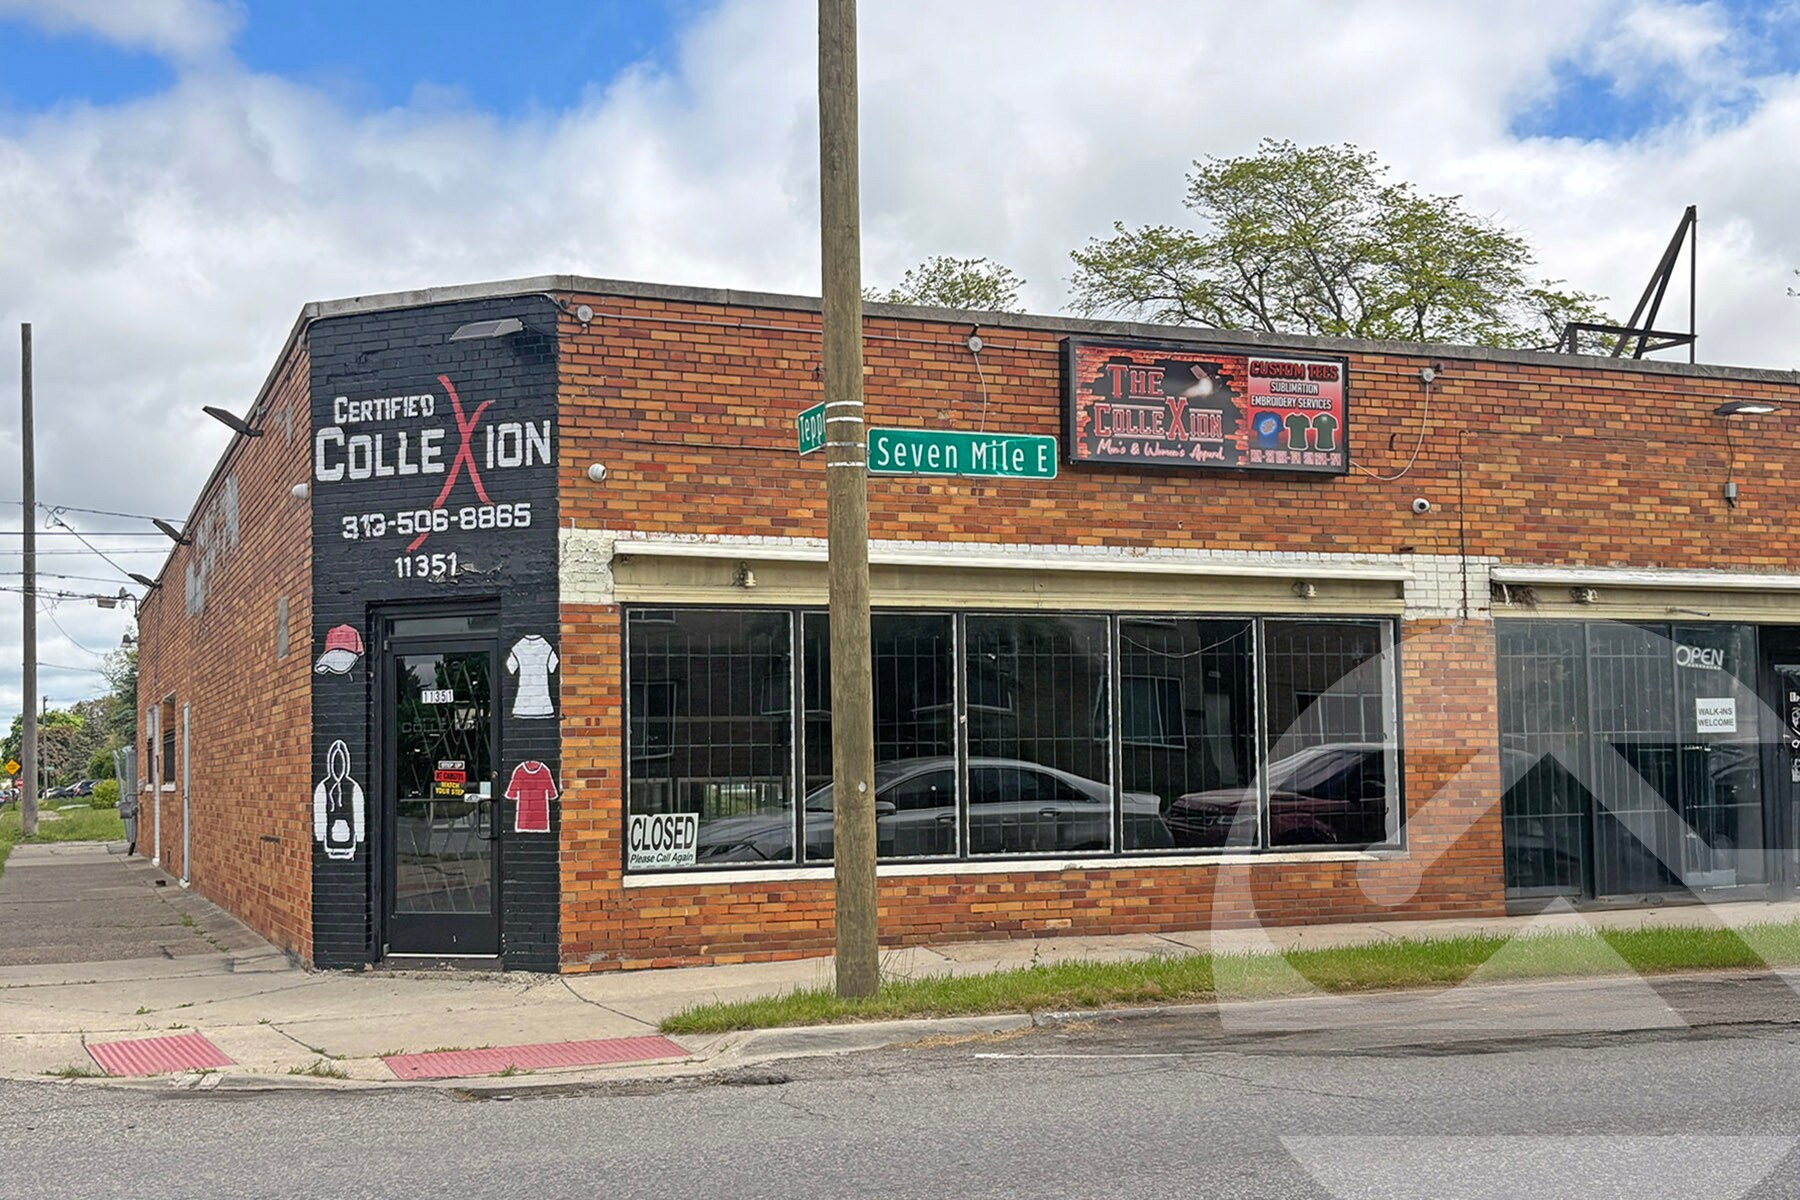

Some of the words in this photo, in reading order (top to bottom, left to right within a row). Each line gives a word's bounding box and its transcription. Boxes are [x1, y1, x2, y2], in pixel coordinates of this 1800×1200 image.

[1106, 364, 1164, 398] THE
[1250, 361, 1305, 379] CUSTOM
[1307, 364, 1339, 381] TEES
[1270, 381, 1319, 395] SUBLIMATION
[333, 394, 435, 424] CERTIFIED
[1251, 395, 1297, 408] EMBROIDERY
[1297, 398, 1332, 411] SERVICES
[800, 410, 826, 448] Tepp
[1094, 396, 1222, 441] COLLEXION
[877, 436, 958, 470] Seven
[972, 439, 1025, 472] Mile
[1037, 444, 1048, 472] E
[1130, 442, 1140, 456] &
[342, 502, 531, 540] 313-506-8865
[394, 552, 458, 578] 11351
[1675, 645, 1724, 667] OPEN
[423, 690, 453, 703] 11351
[1698, 707, 1733, 716] WALK-INS
[1698, 718, 1734, 727] WELCOME
[630, 816, 695, 851] CLOSED
[630, 853, 655, 863] Please
[656, 852, 671, 863] Call
[672, 851, 693, 864] Again
